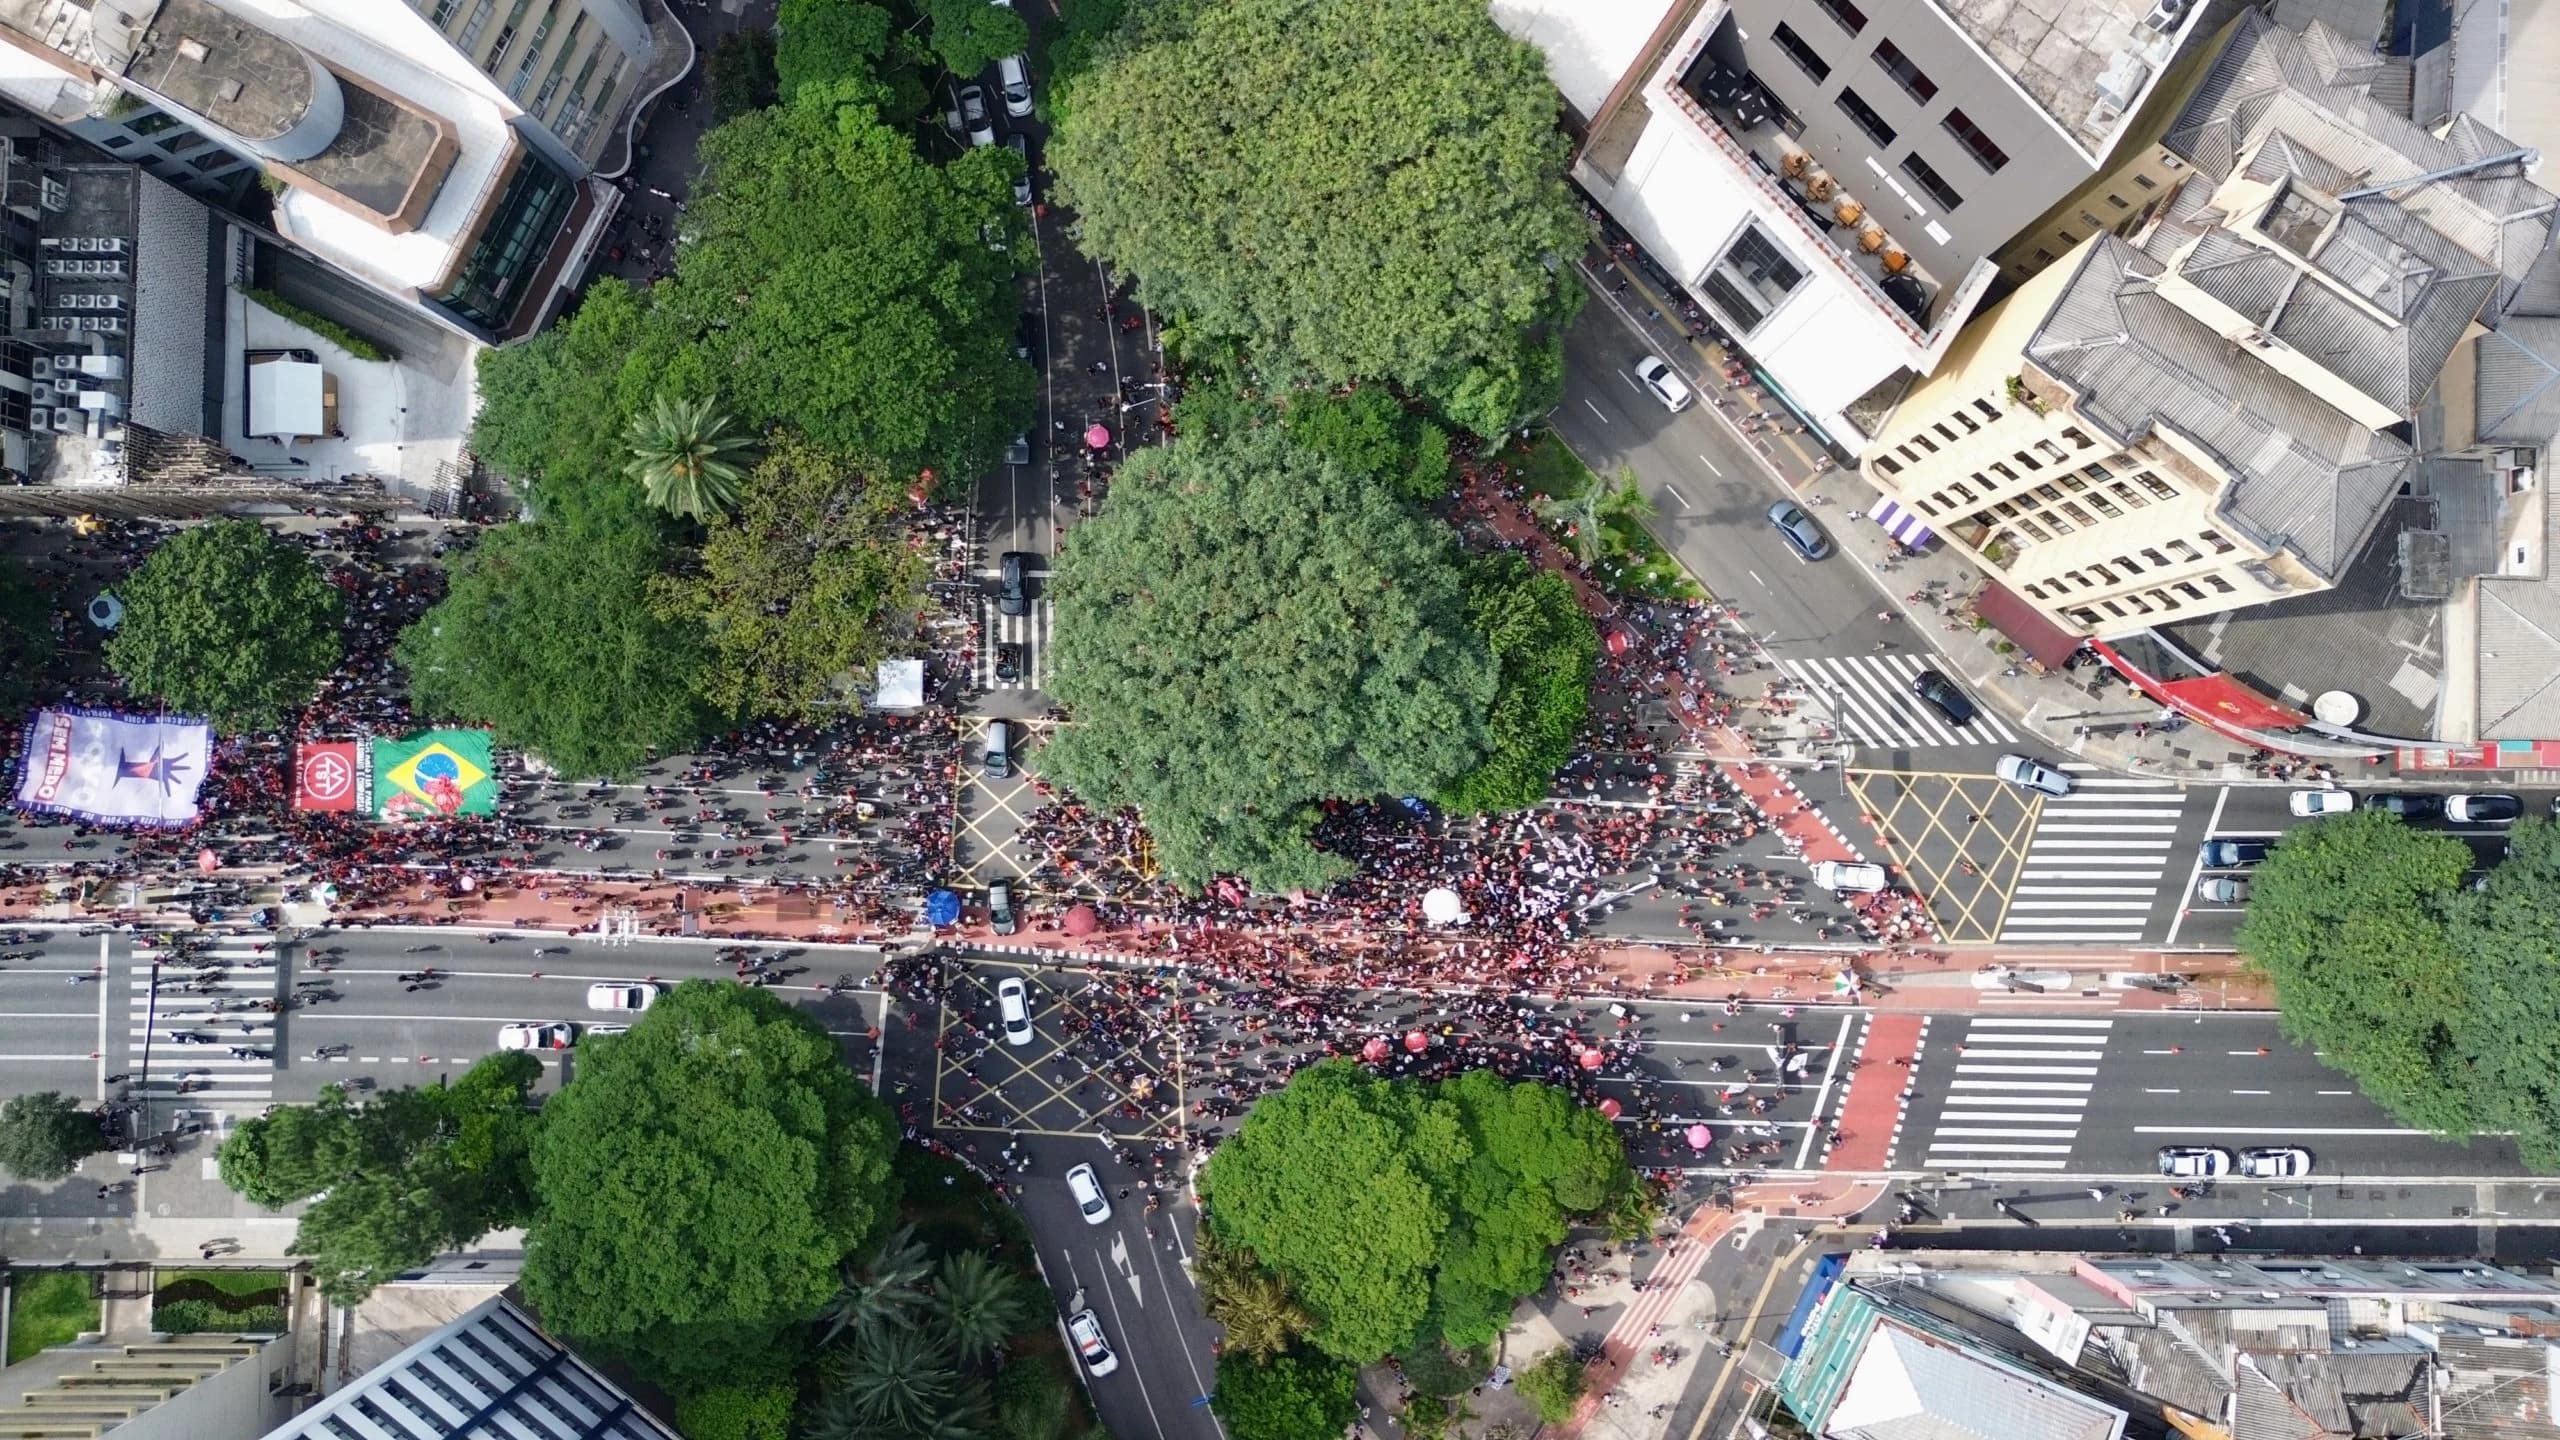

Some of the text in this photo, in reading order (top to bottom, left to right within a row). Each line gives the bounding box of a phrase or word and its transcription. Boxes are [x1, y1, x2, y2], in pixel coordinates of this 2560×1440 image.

[38, 716, 70, 799] SEM MEDO
[364, 790, 373, 812] PARA
[101, 815, 122, 824] POVO
